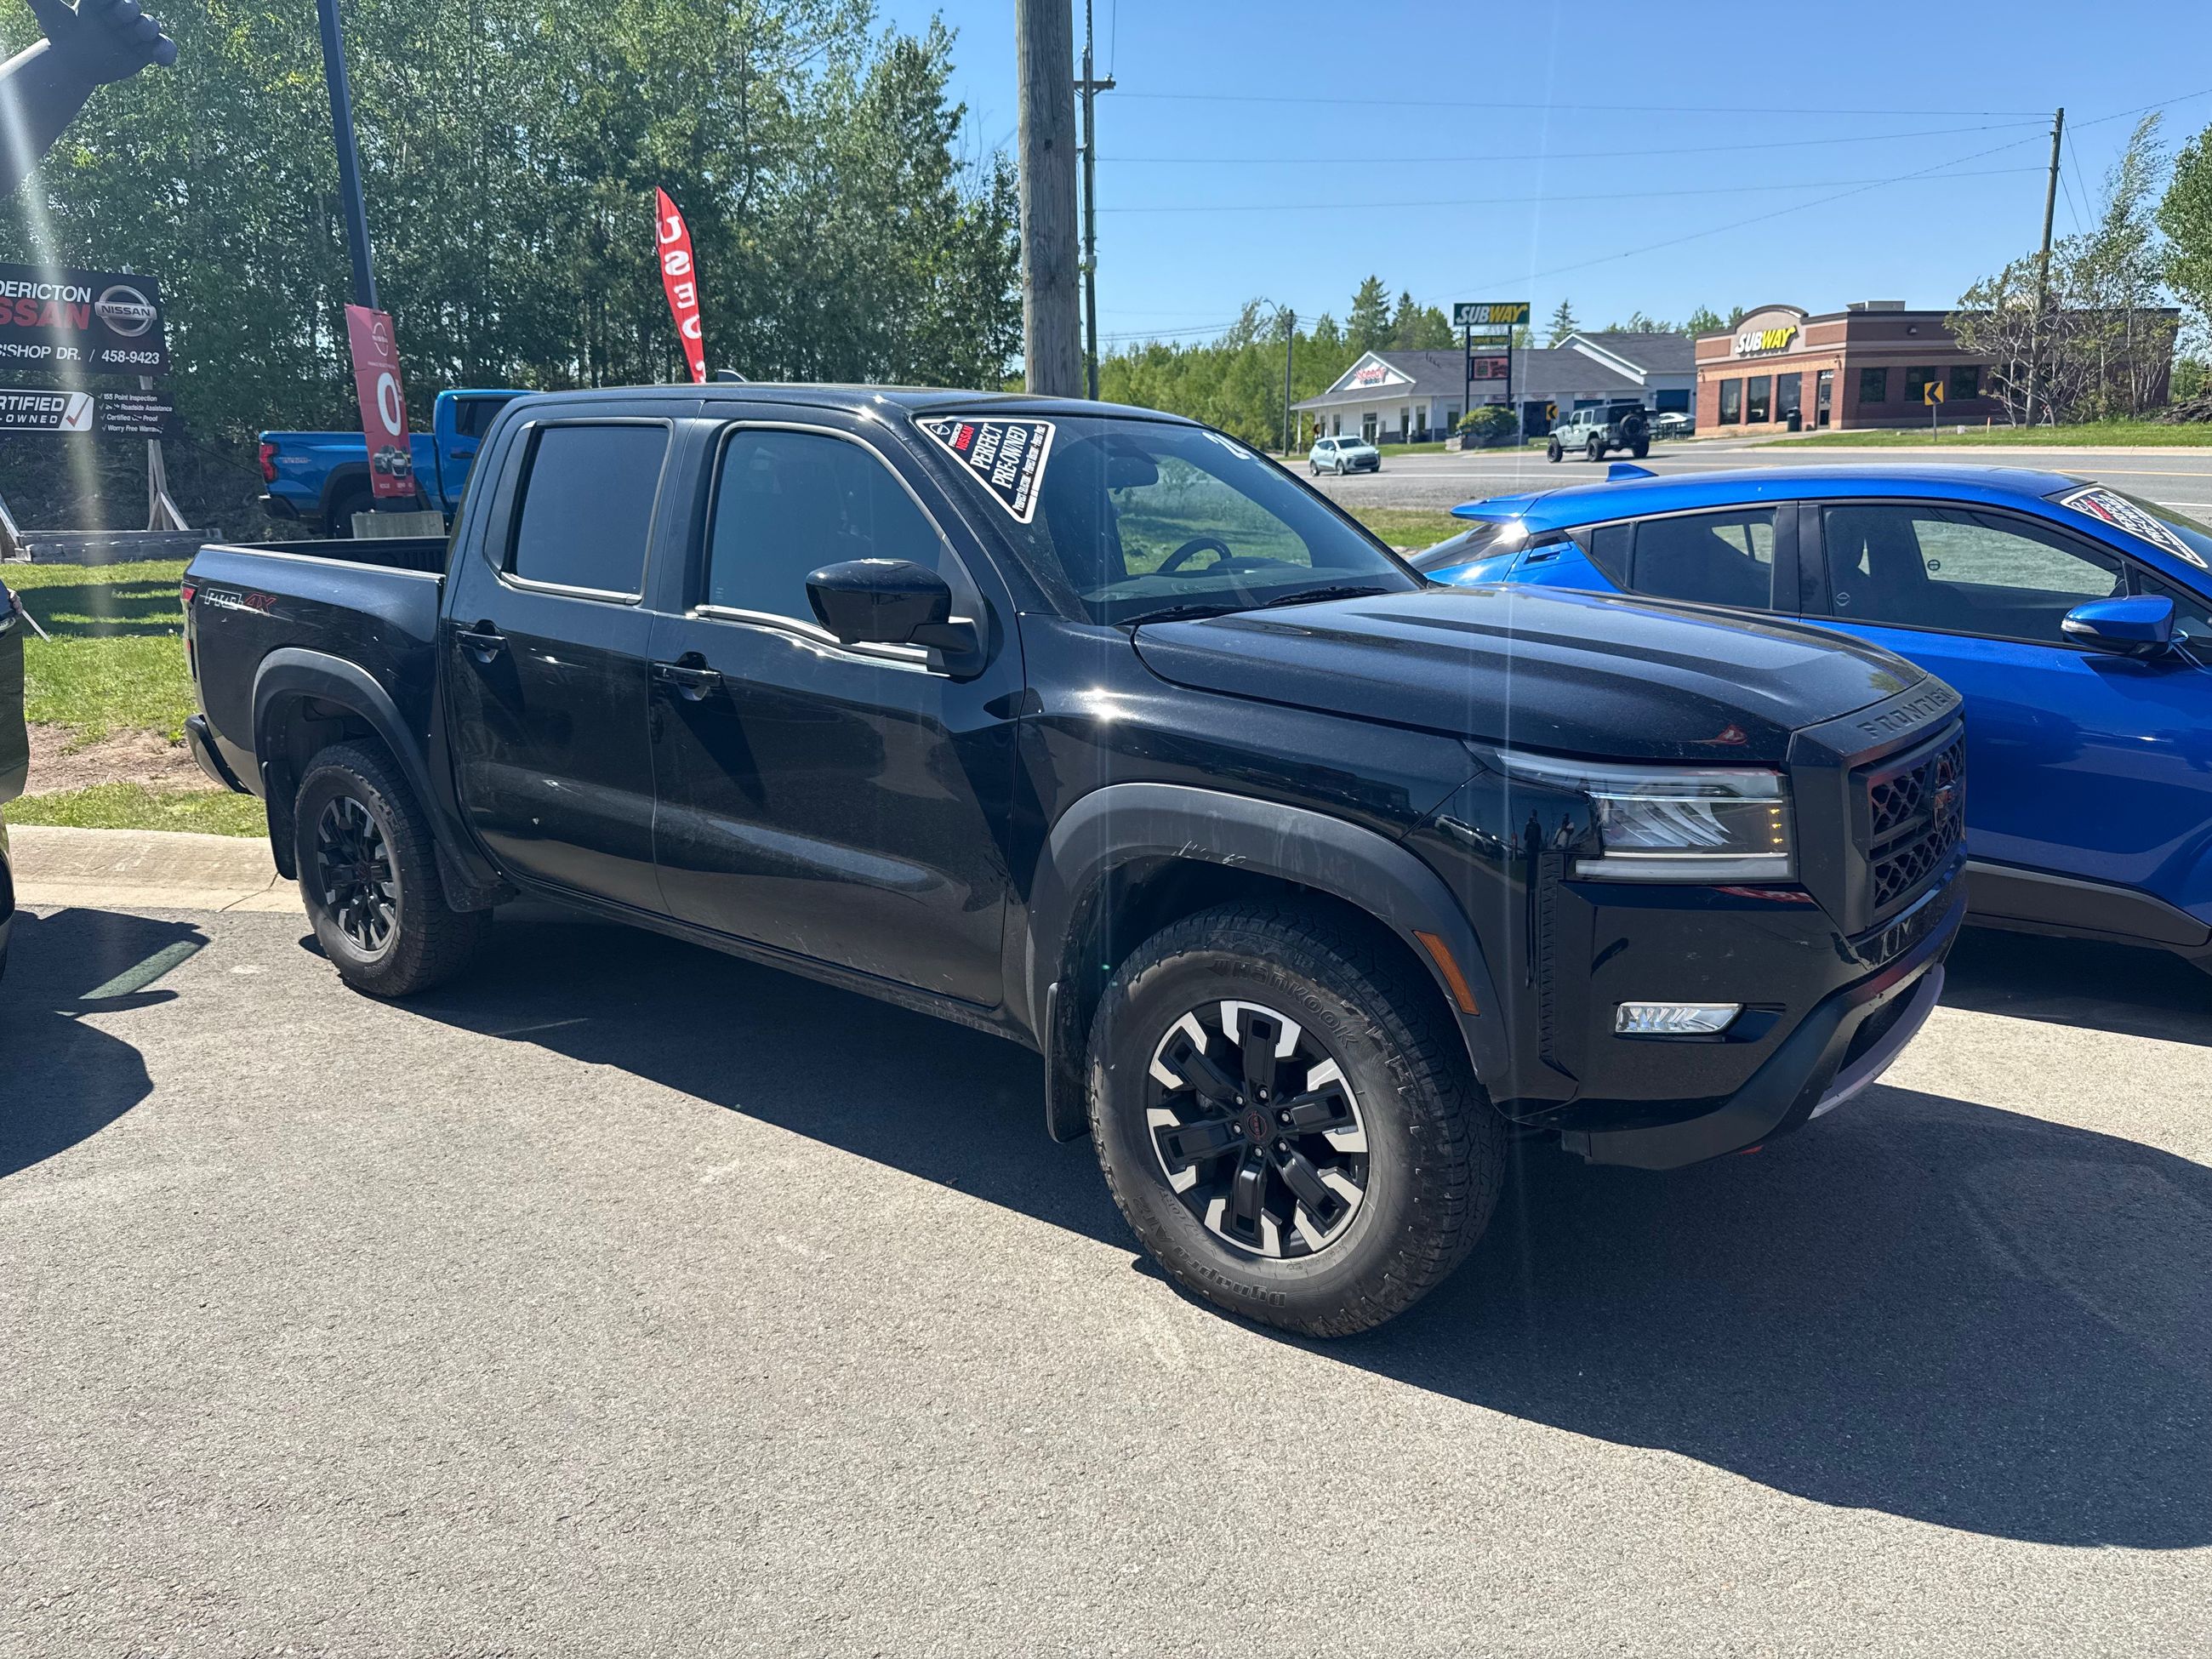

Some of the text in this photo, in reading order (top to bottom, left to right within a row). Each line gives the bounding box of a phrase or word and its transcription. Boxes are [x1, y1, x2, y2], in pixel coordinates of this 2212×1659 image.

[101, 305, 151, 316] NISSAN
[1456, 304, 1528, 323] SUBWAY
[1735, 326, 1796, 353] SUBWAY
[0, 344, 51, 358] ISHOP
[56, 347, 82, 360] DR.
[101, 350, 160, 364] 458-9423
[107, 425, 125, 433] Worry
[955, 425, 974, 451] NISSAN
[969, 422, 1003, 470] PERFECT
[991, 425, 1028, 489] PRE-OWNED
[1856, 687, 1954, 739] FRONTIER
[1172, 1246, 1286, 1308] Dynapro
